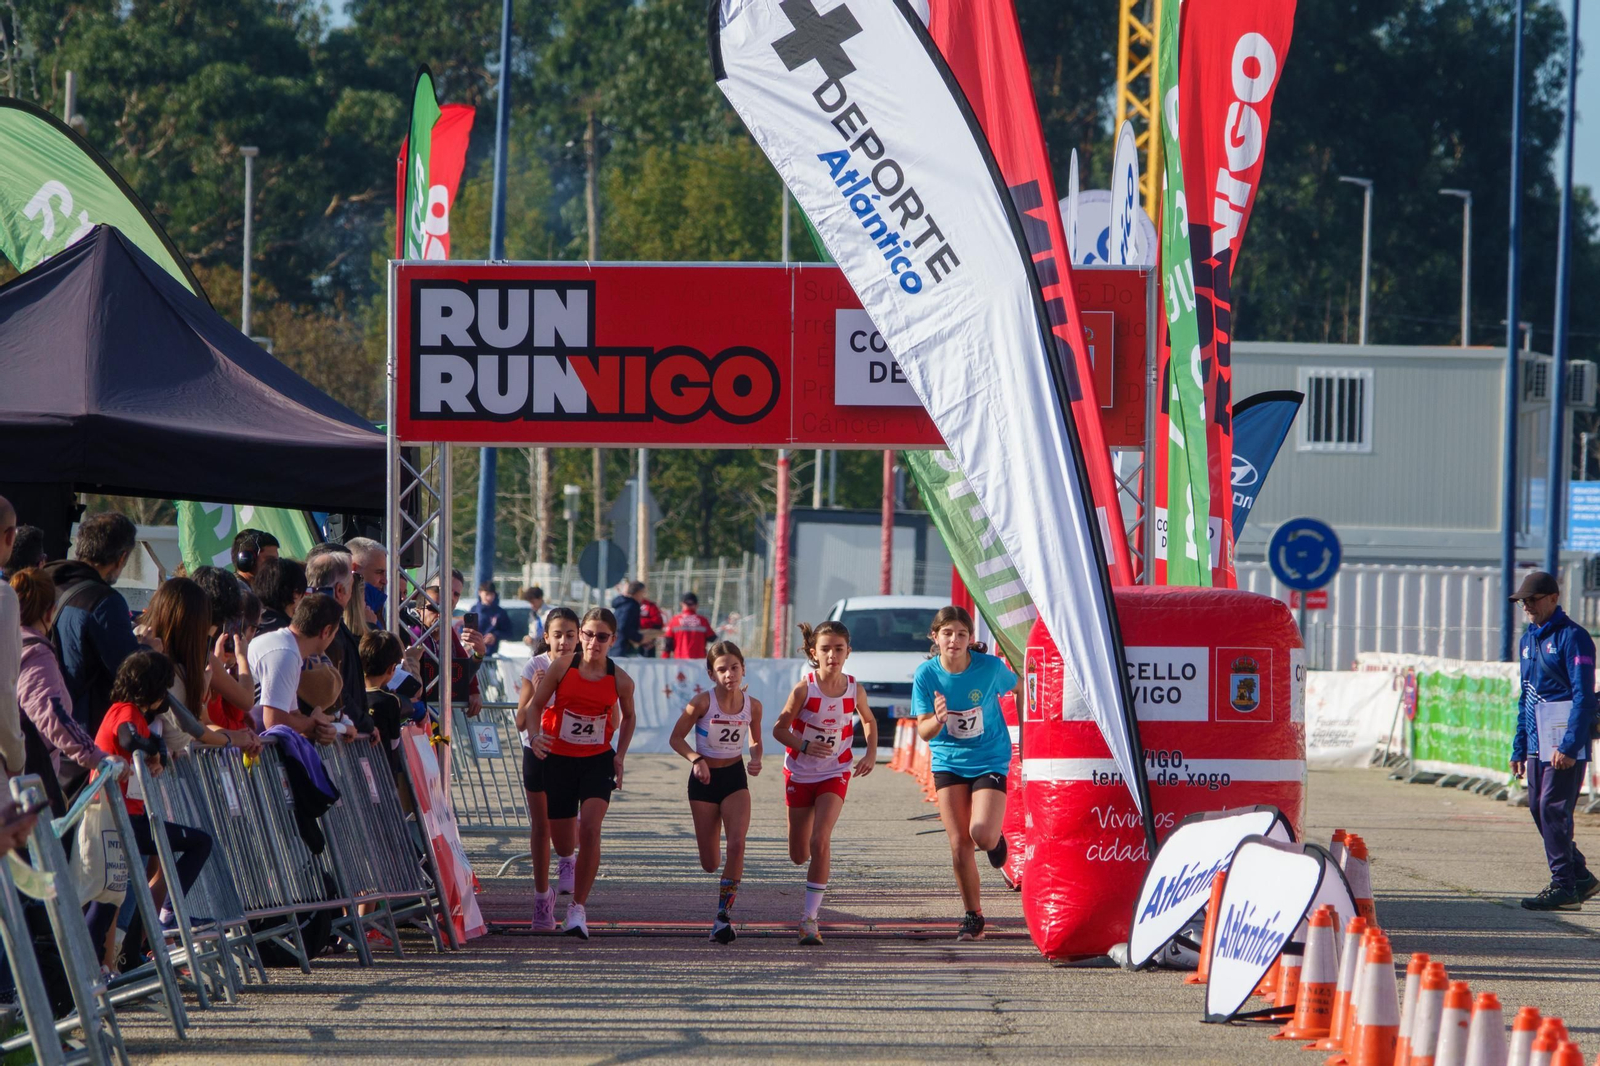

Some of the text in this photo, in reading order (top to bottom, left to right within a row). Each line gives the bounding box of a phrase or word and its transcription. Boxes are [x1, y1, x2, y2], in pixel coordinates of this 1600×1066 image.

[1212, 32, 1278, 261] VIGO
[812, 77, 960, 284] DEPORTE
[817, 147, 923, 296] Atlántico
[419, 288, 588, 348] RUN
[868, 360, 908, 384] DE
[803, 410, 887, 435] Cáncer
[571, 722, 595, 736] 24
[719, 728, 741, 743] 26
[957, 716, 977, 731] 27
[1156, 769, 1179, 786] de
[1185, 771, 1231, 791] xogo
[1086, 838, 1151, 862] cidad
[1216, 901, 1285, 967] Atlántico
